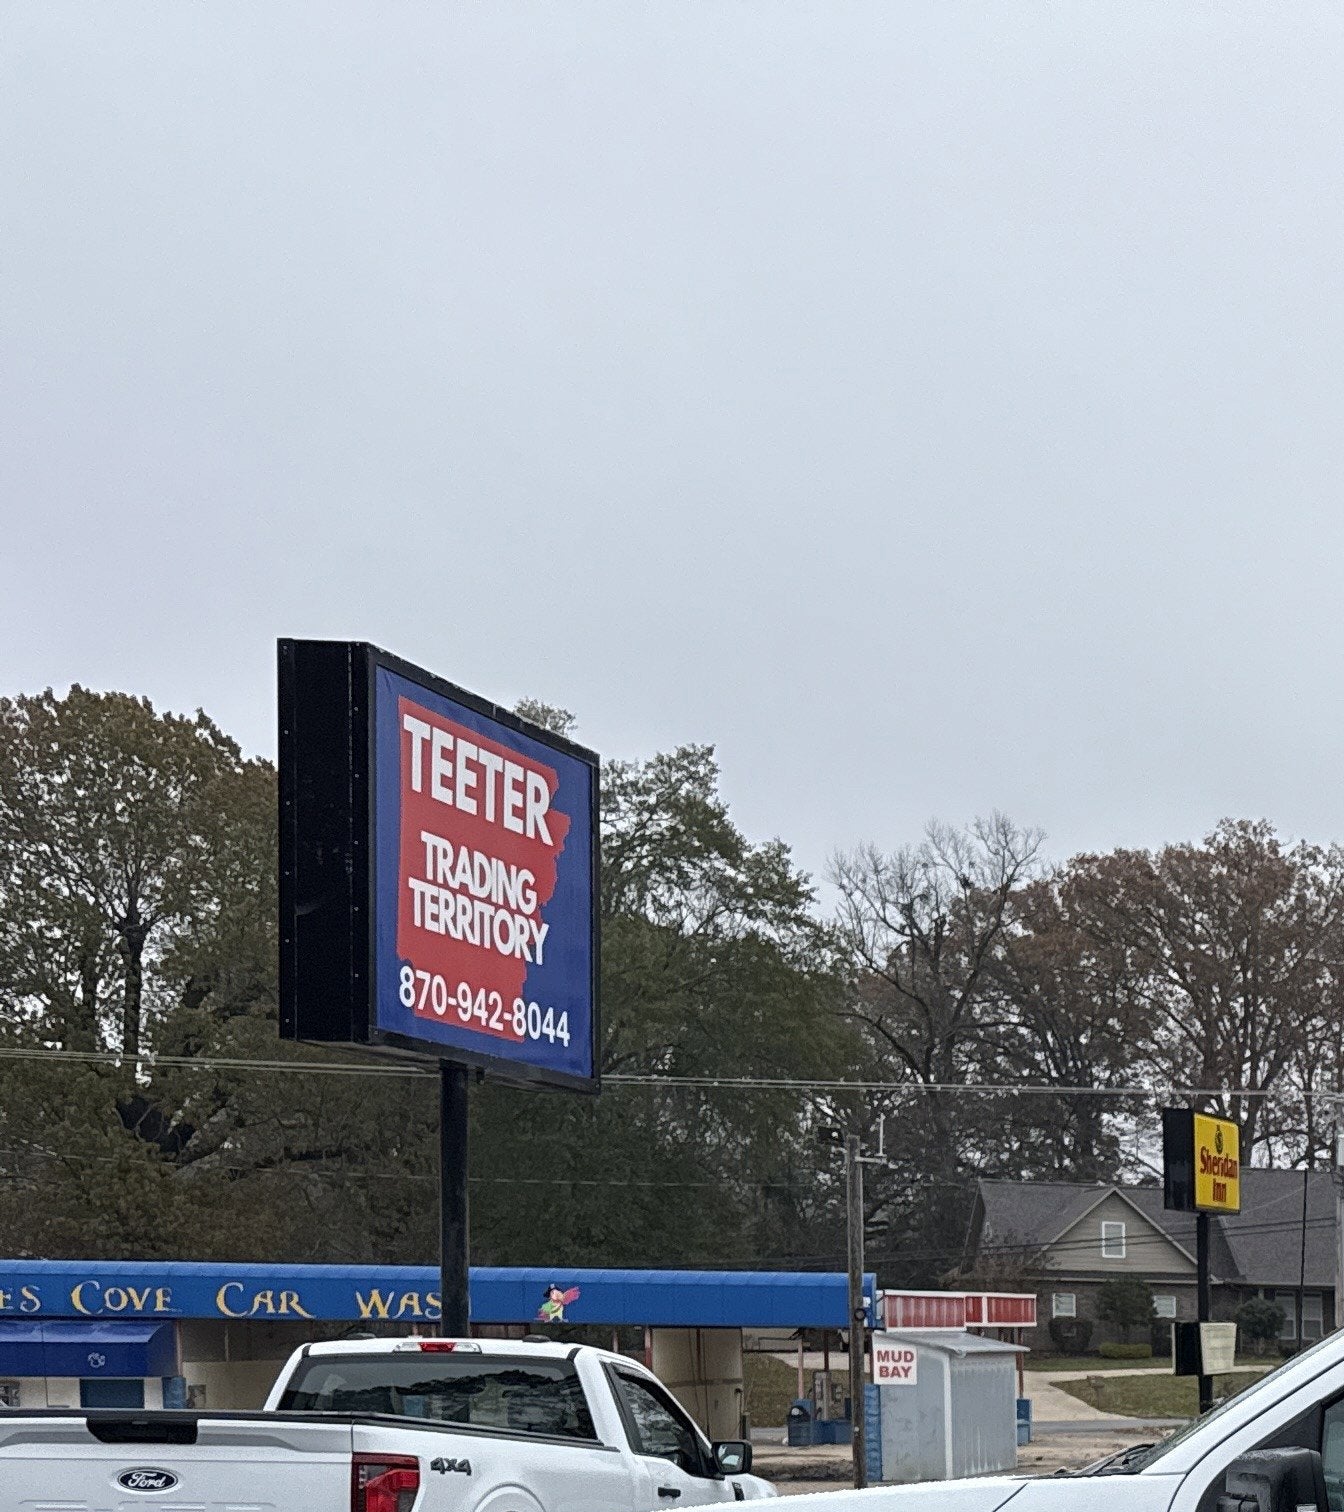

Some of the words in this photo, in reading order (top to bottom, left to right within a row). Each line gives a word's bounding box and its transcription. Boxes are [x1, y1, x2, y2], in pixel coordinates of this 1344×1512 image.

[403, 713, 554, 847] TEETER
[420, 830, 538, 916] TRADING
[408, 877, 550, 966] TERRITORY
[399, 965, 571, 1048] 870-942-8044
[1200, 1146, 1238, 1179] Sheridan
[877, 1350, 915, 1363] MUD
[880, 1365, 912, 1378] BAY
[128, 1472, 166, 1489] Ford
